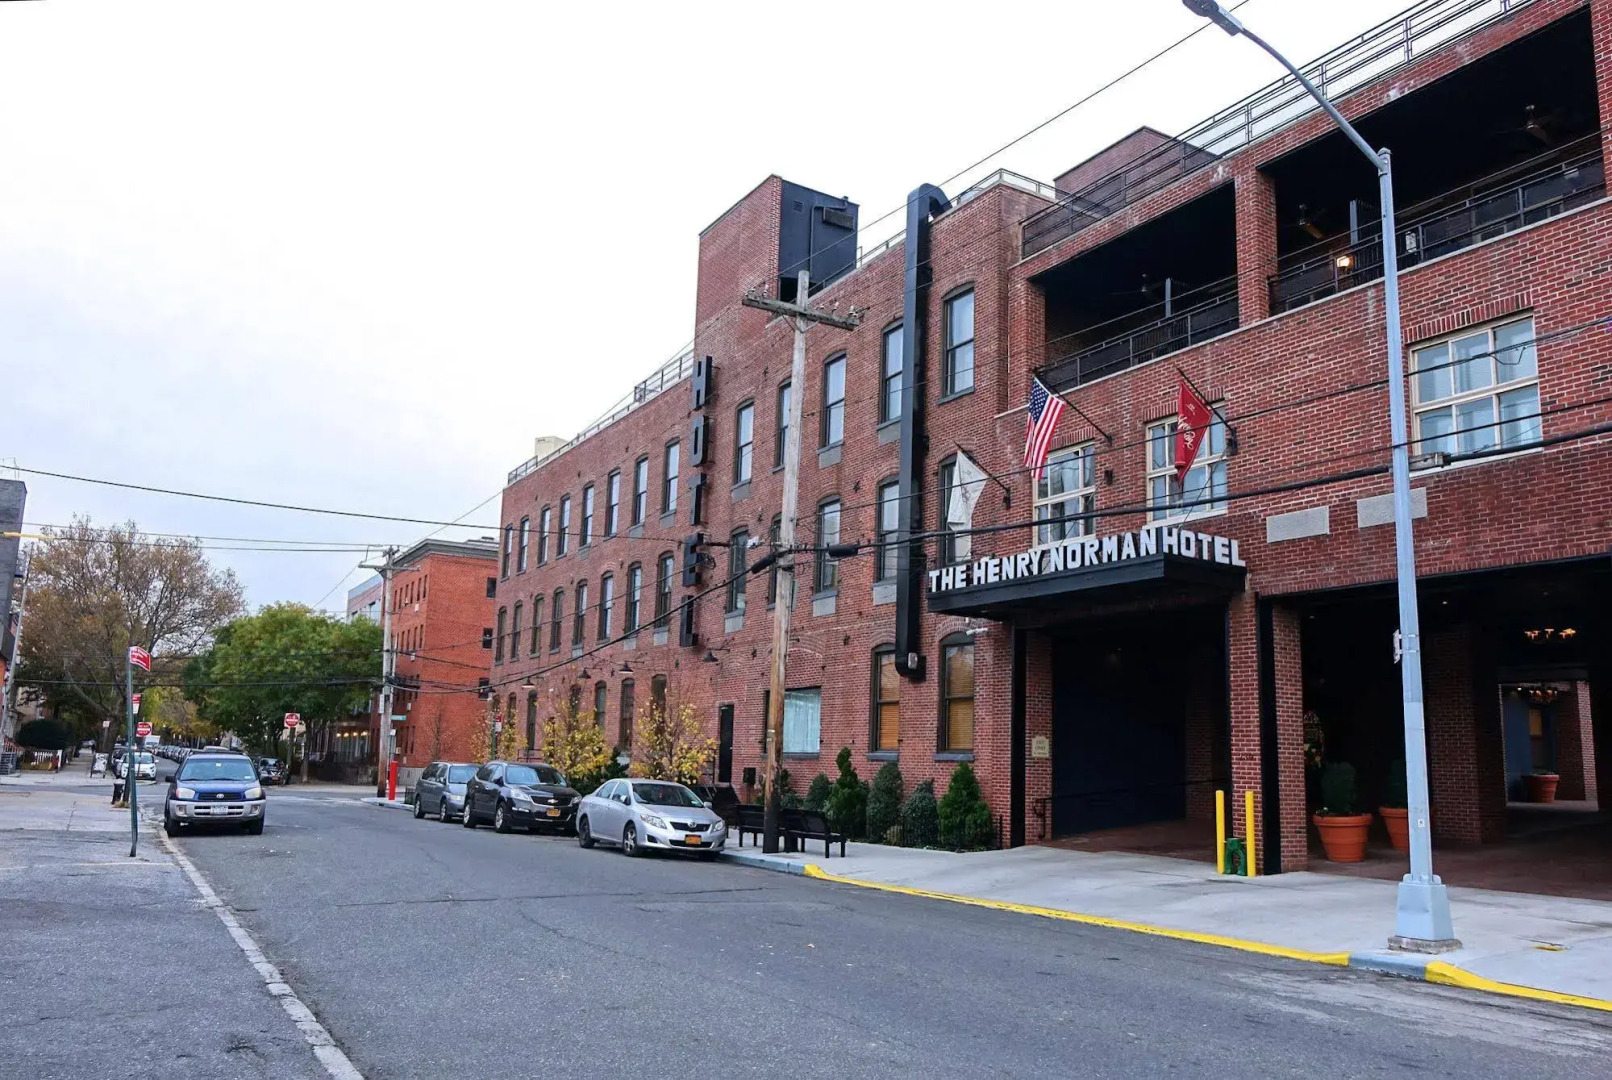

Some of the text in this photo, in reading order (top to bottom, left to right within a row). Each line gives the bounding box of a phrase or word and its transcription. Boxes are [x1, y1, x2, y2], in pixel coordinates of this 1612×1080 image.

[680, 355, 713, 647] HOTEL
[929, 526, 1246, 592] THE HENRY NORMAN HOTEL
